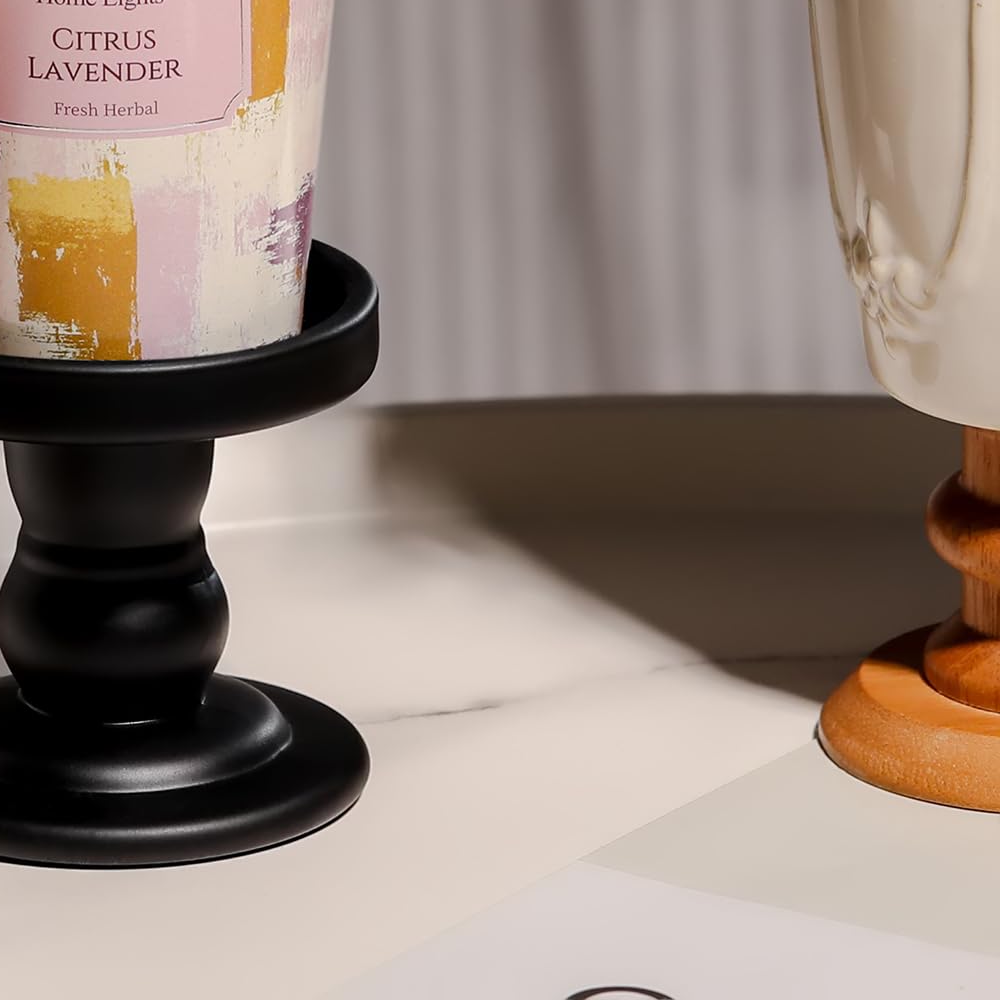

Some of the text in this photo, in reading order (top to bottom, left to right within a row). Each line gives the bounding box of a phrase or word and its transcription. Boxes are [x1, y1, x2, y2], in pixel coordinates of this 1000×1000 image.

[52, 27, 157, 52] CITRUS
[27, 55, 184, 83] LAVENDER
[54, 100, 159, 118] Fresh Herbal
